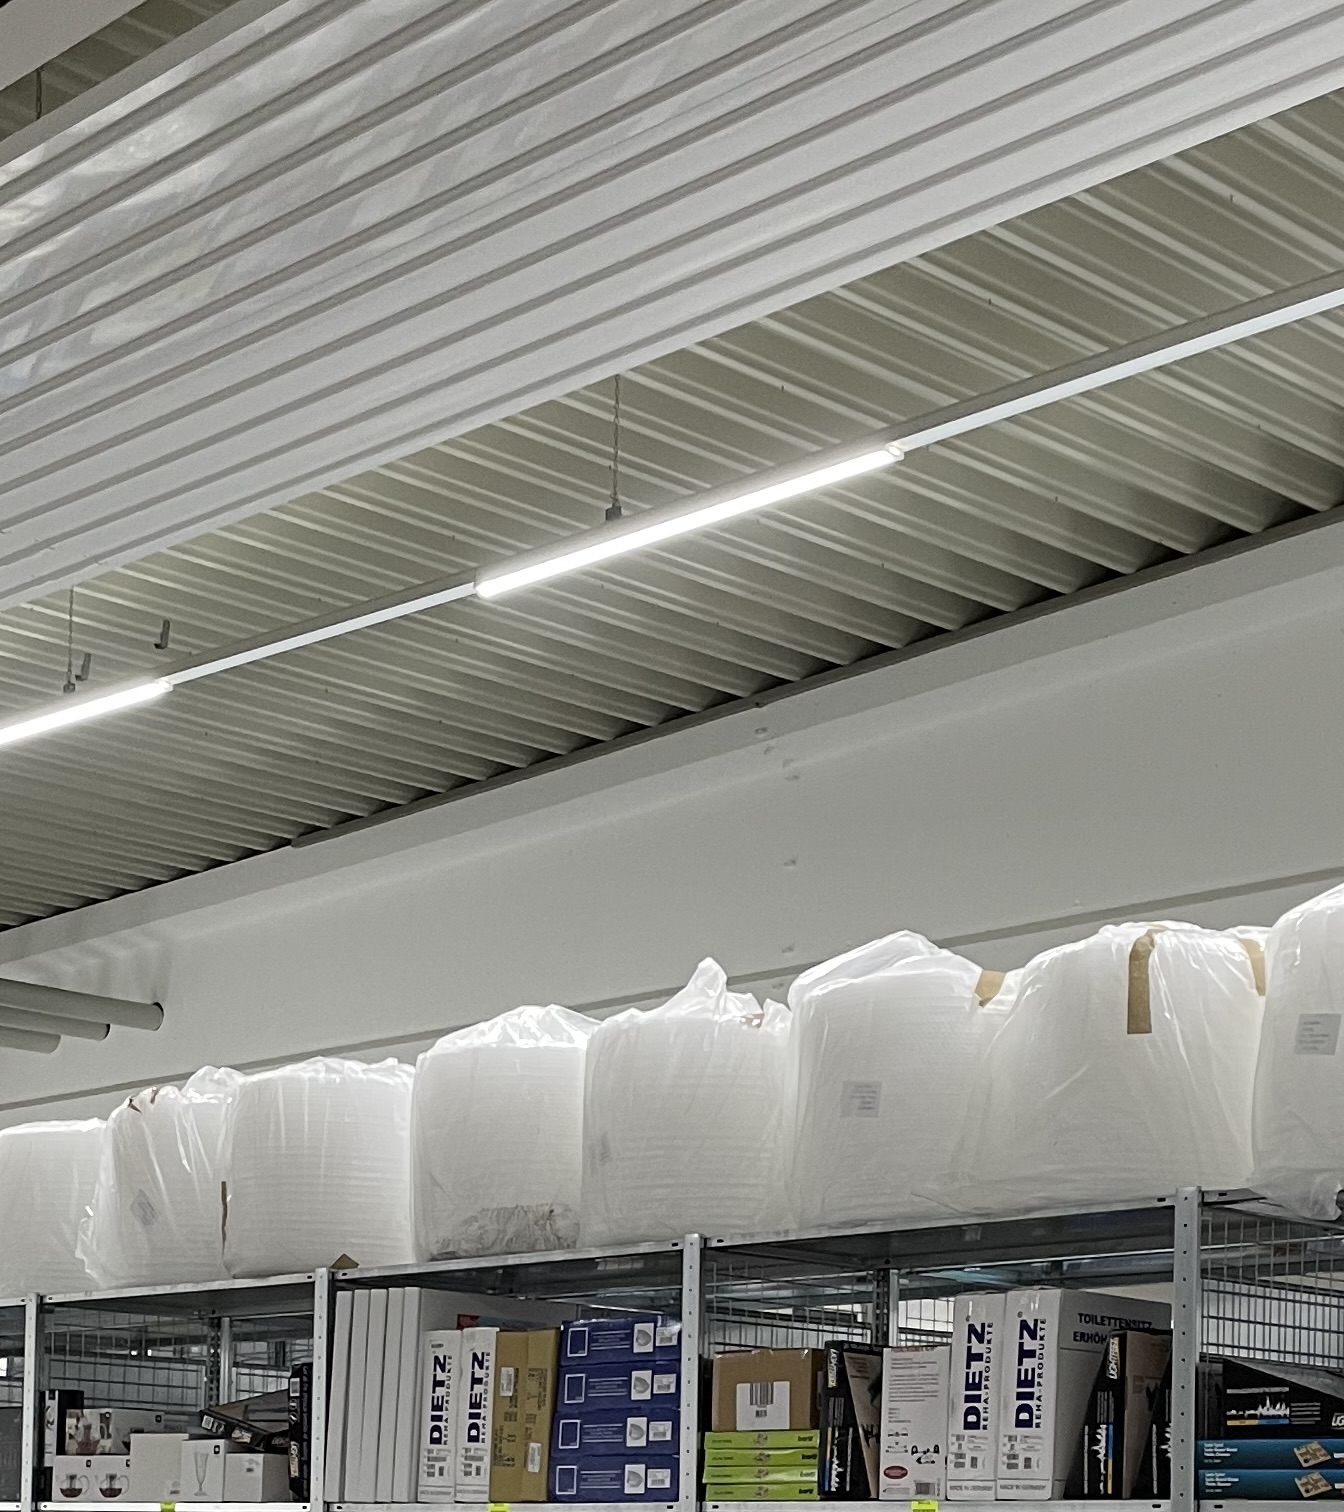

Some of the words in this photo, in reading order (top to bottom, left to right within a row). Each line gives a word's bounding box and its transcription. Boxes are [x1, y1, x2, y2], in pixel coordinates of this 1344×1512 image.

[1014, 1318, 1039, 1429] DIETZ
[1034, 1318, 1047, 1429] REHA-PRODUKTE
[1077, 1312, 1153, 1330] TOILETTENSITZ
[429, 1354, 447, 1446] DIETZ
[467, 1351, 485, 1444] DIETZ
[963, 1322, 986, 1431] DIETZ
[982, 1321, 994, 1431] REHA-PRODUKTE
